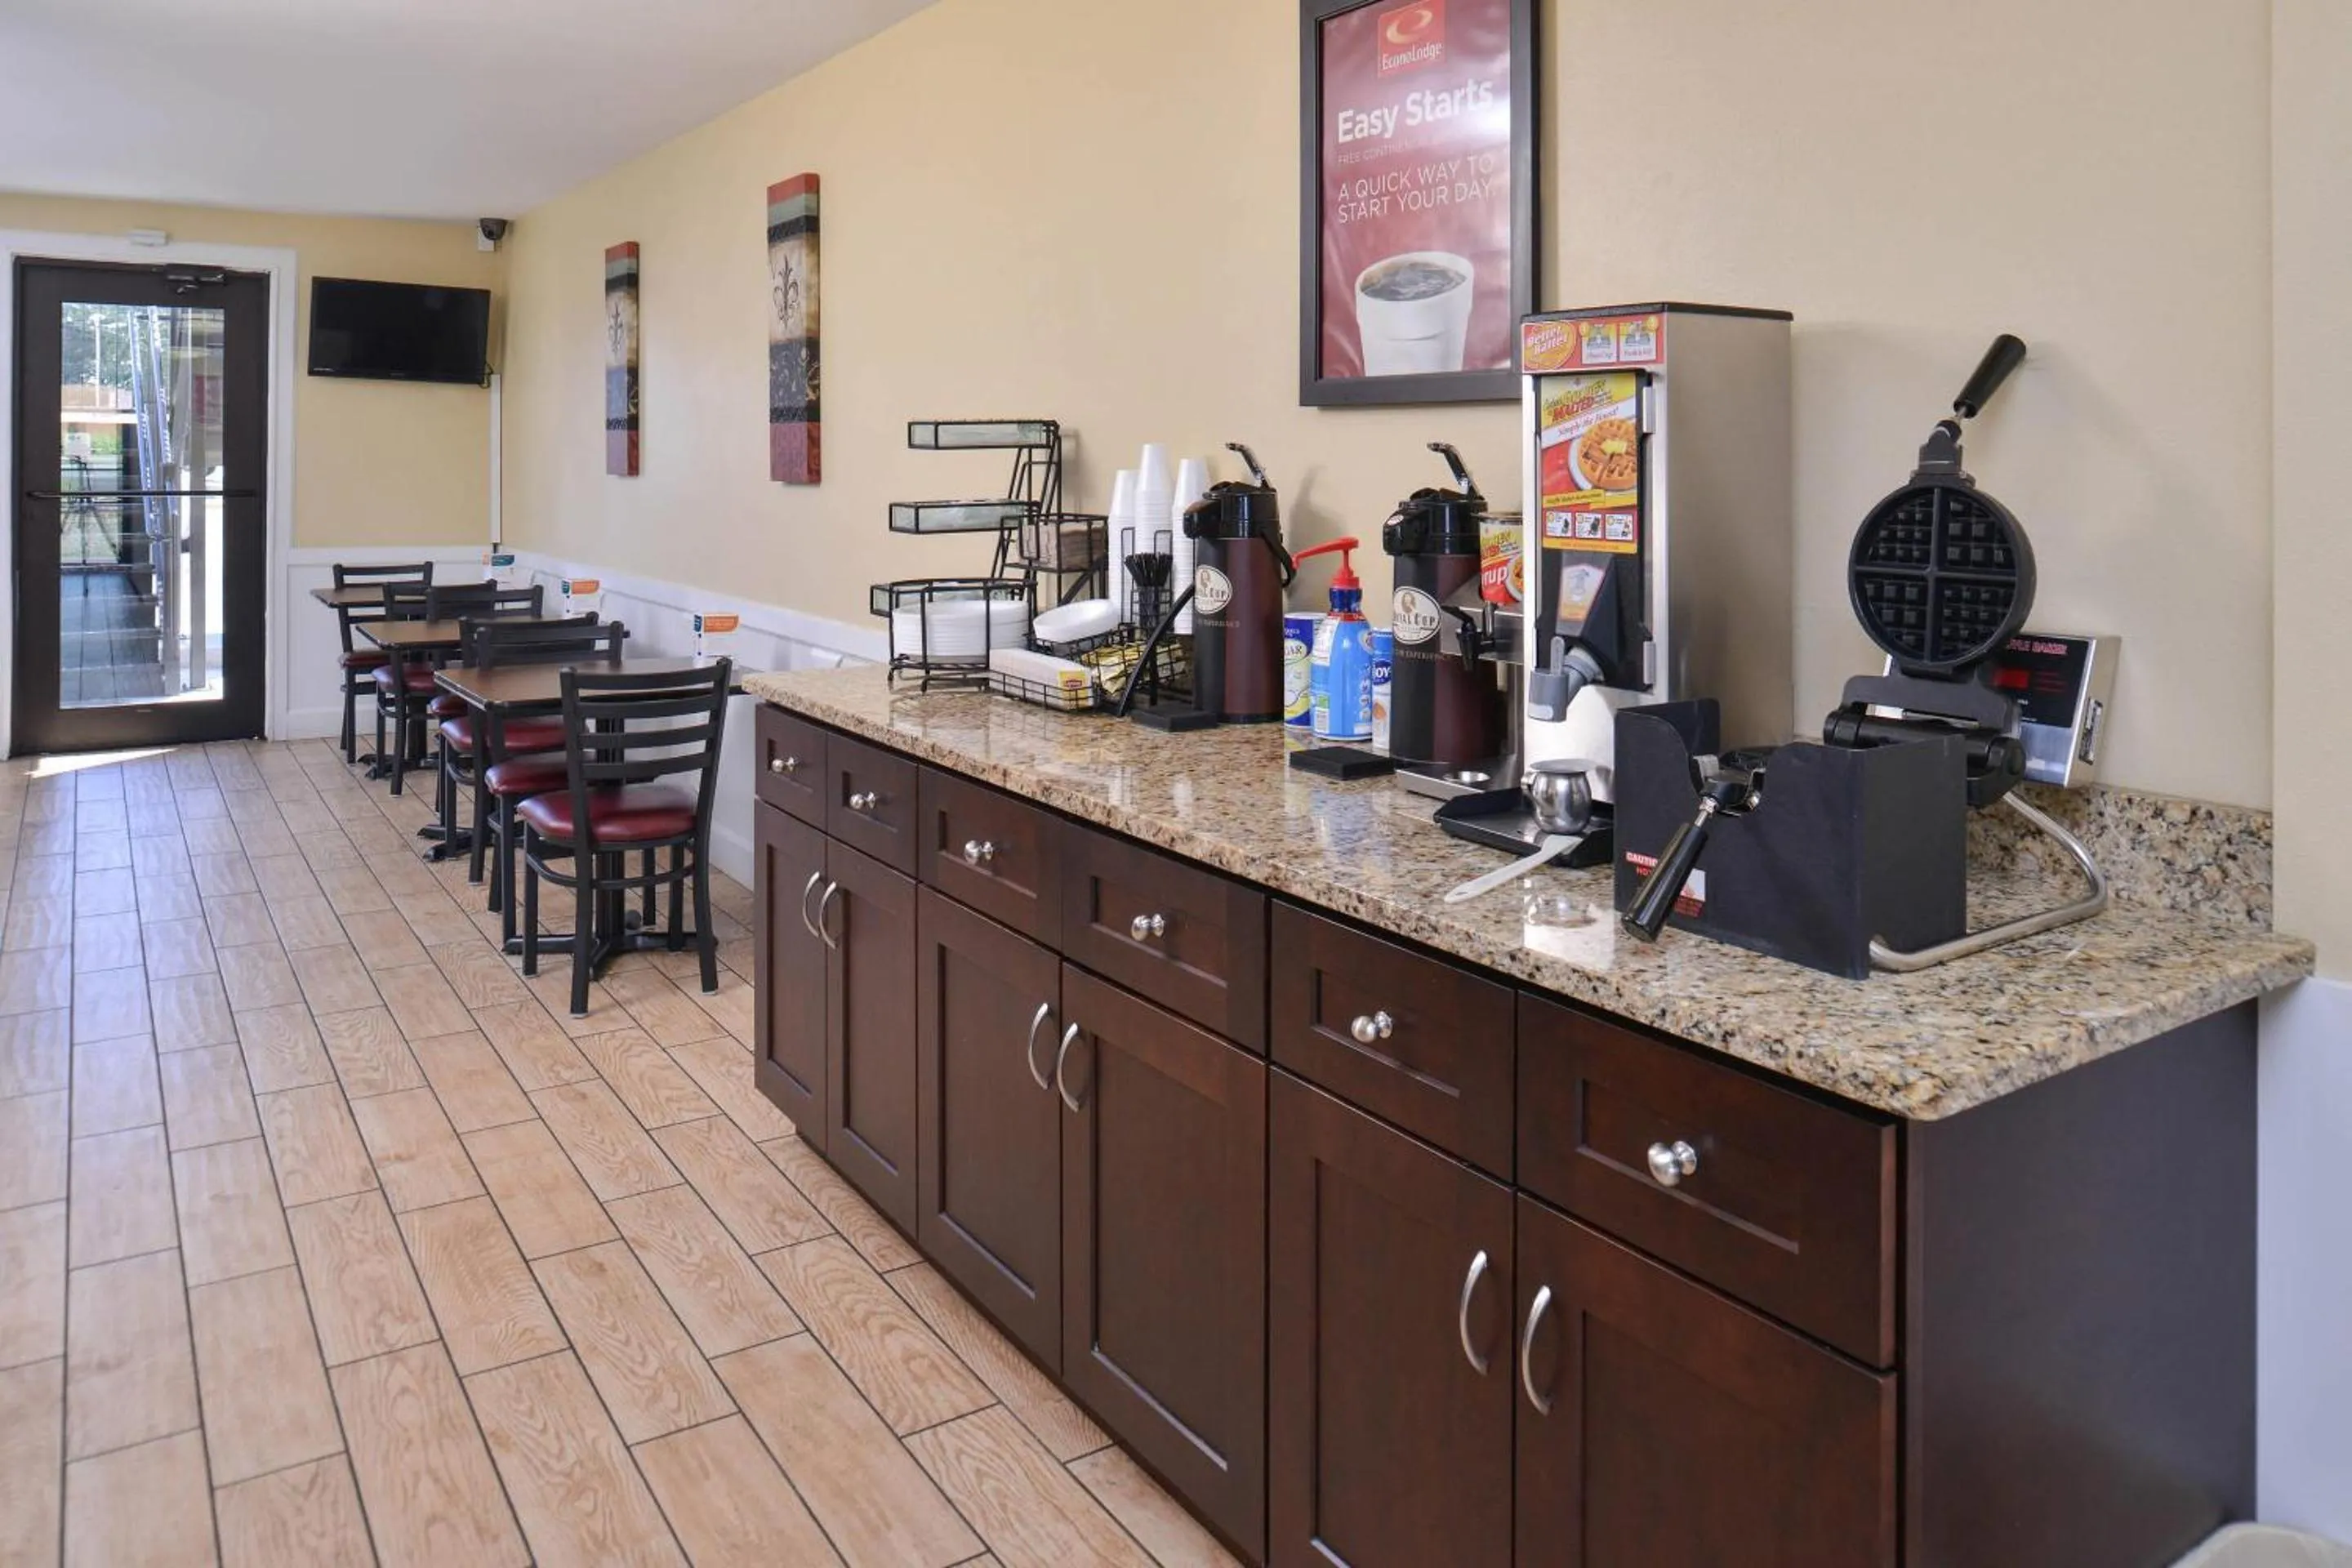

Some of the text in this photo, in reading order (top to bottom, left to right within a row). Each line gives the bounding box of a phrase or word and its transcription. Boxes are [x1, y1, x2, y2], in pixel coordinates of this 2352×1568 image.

[1338, 78, 1494, 144] Easy Starts
[1339, 154, 1494, 202] A QUICK WAY TO
[1338, 196, 1390, 224] START
[1397, 185, 1449, 212] YOUR
[1625, 851, 1659, 866] CAUTIO
